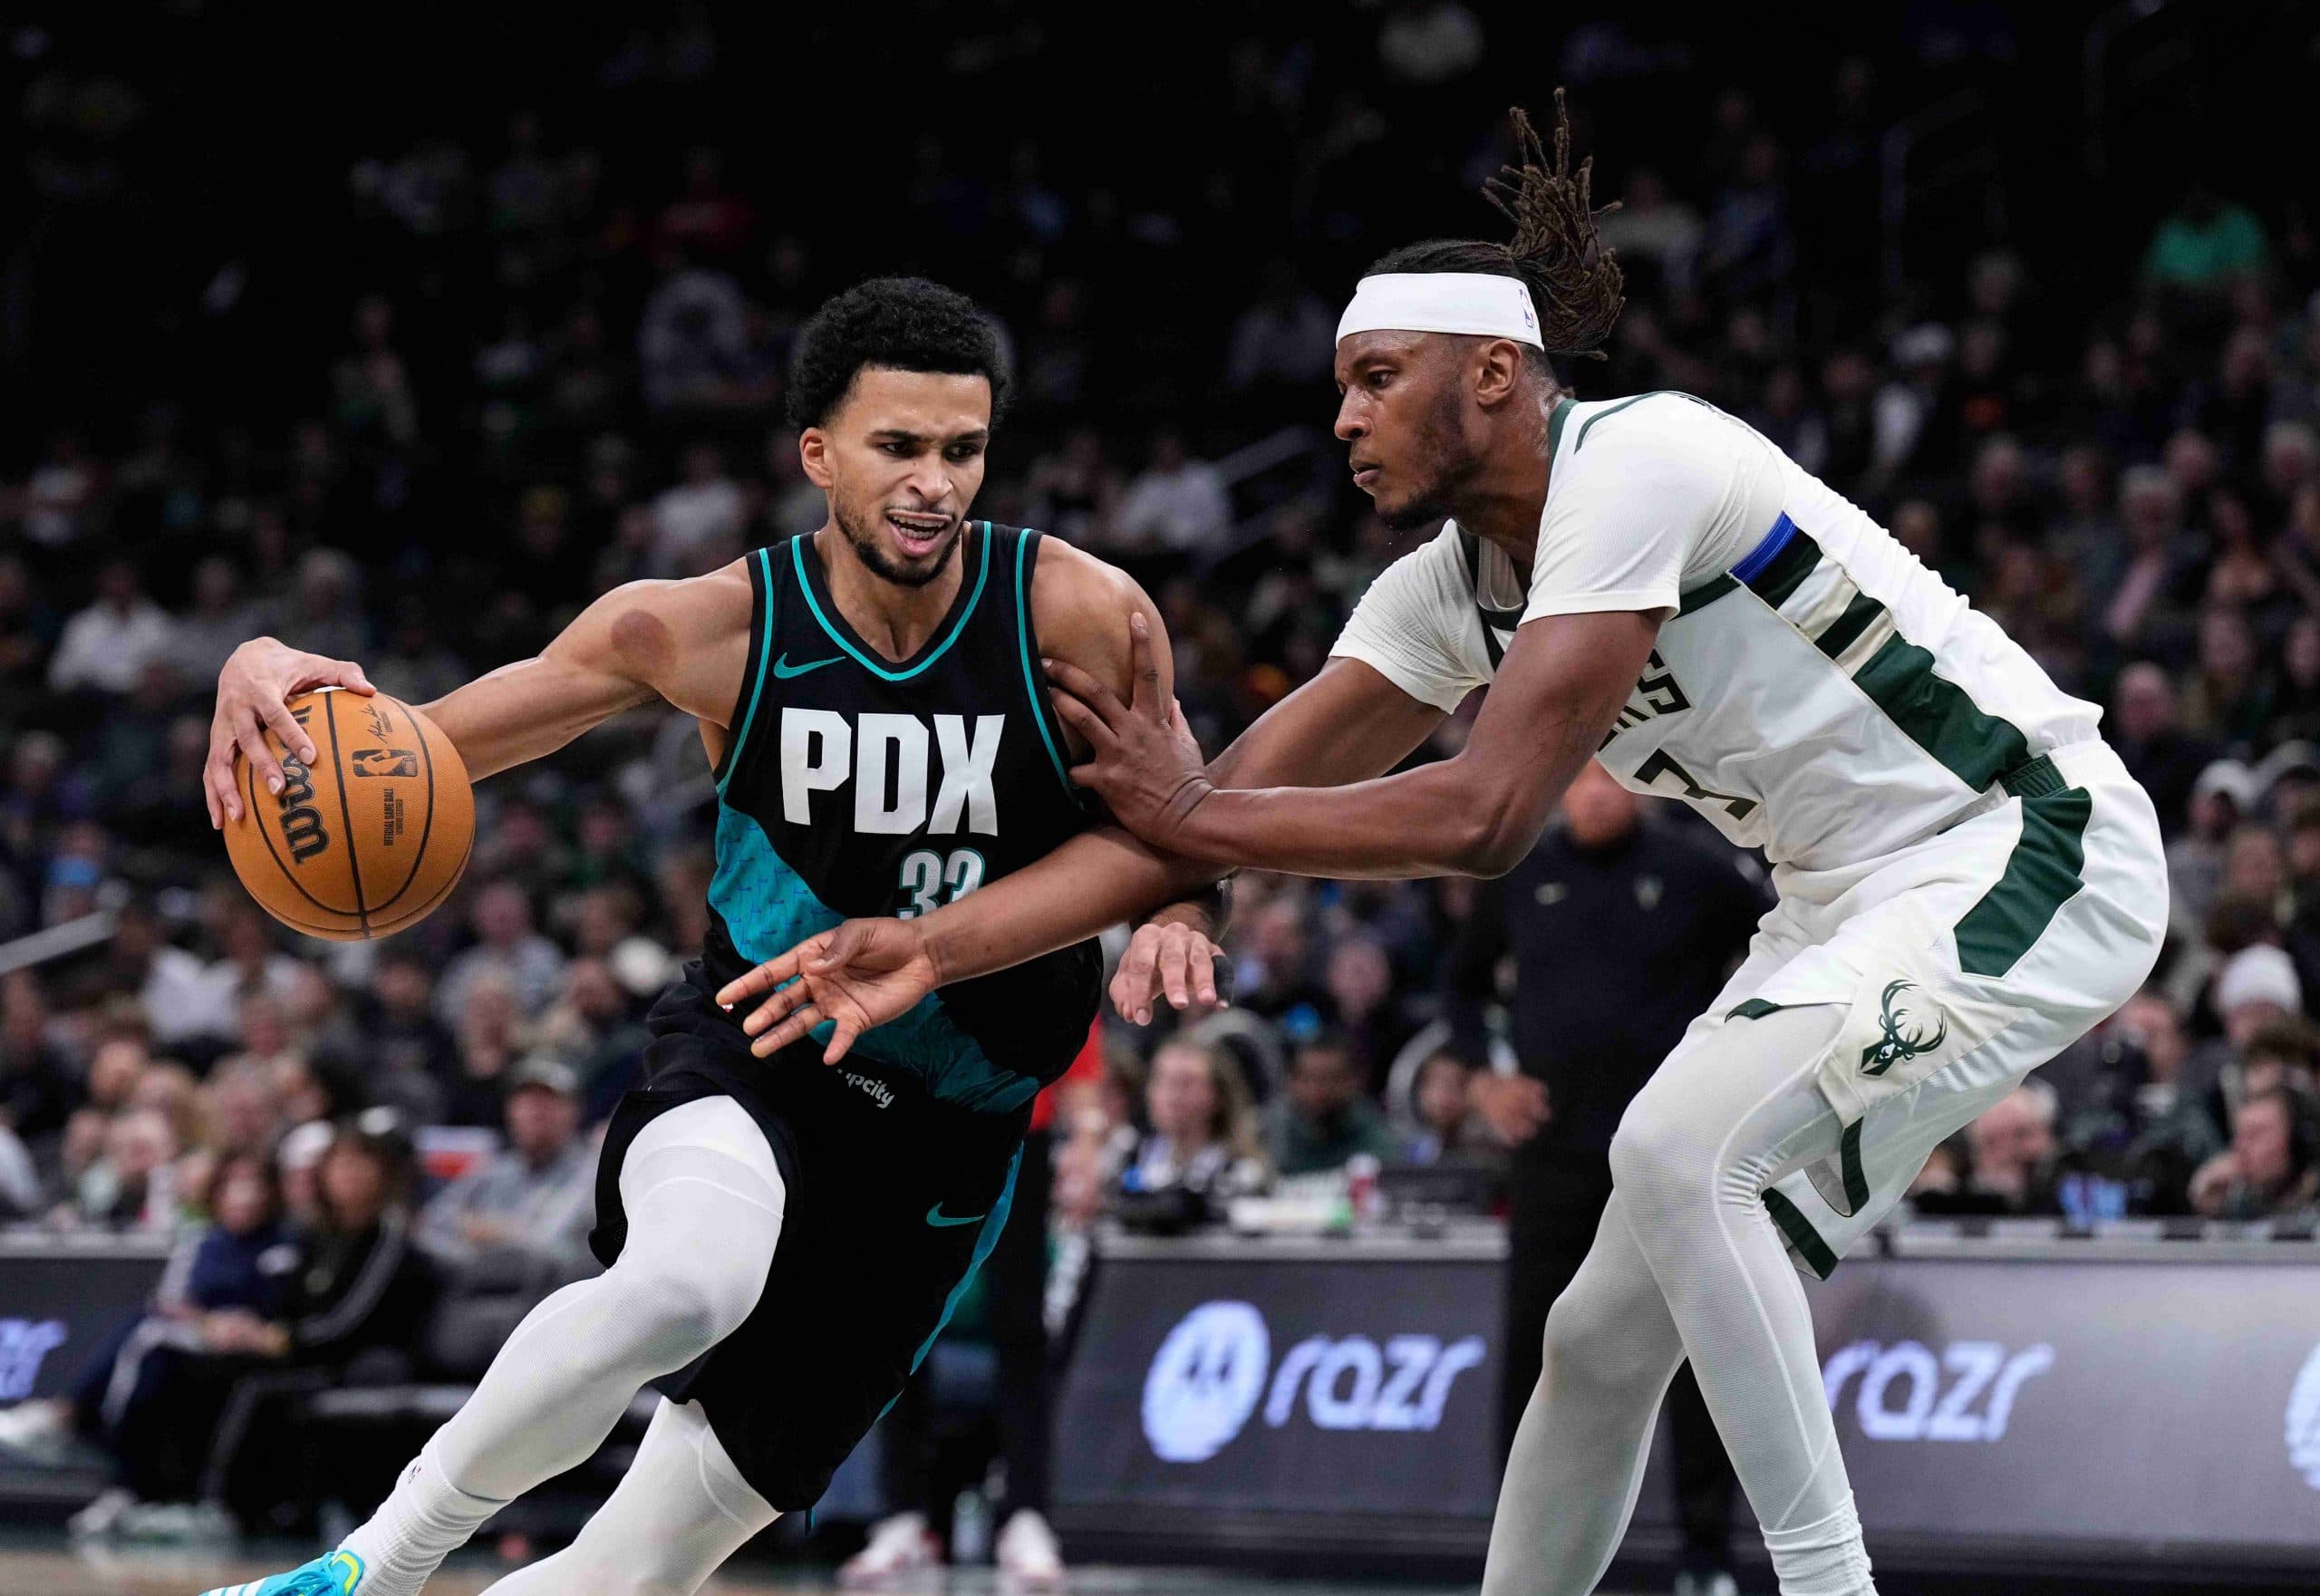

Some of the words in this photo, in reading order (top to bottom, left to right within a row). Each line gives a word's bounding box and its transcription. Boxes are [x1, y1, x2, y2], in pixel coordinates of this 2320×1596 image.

[278, 705, 330, 865] Wil
[780, 707, 1005, 836] PDX
[837, 1069, 895, 1108] pcity
[1263, 1334, 1487, 1431] razr
[1822, 1339, 2055, 1442] razr
